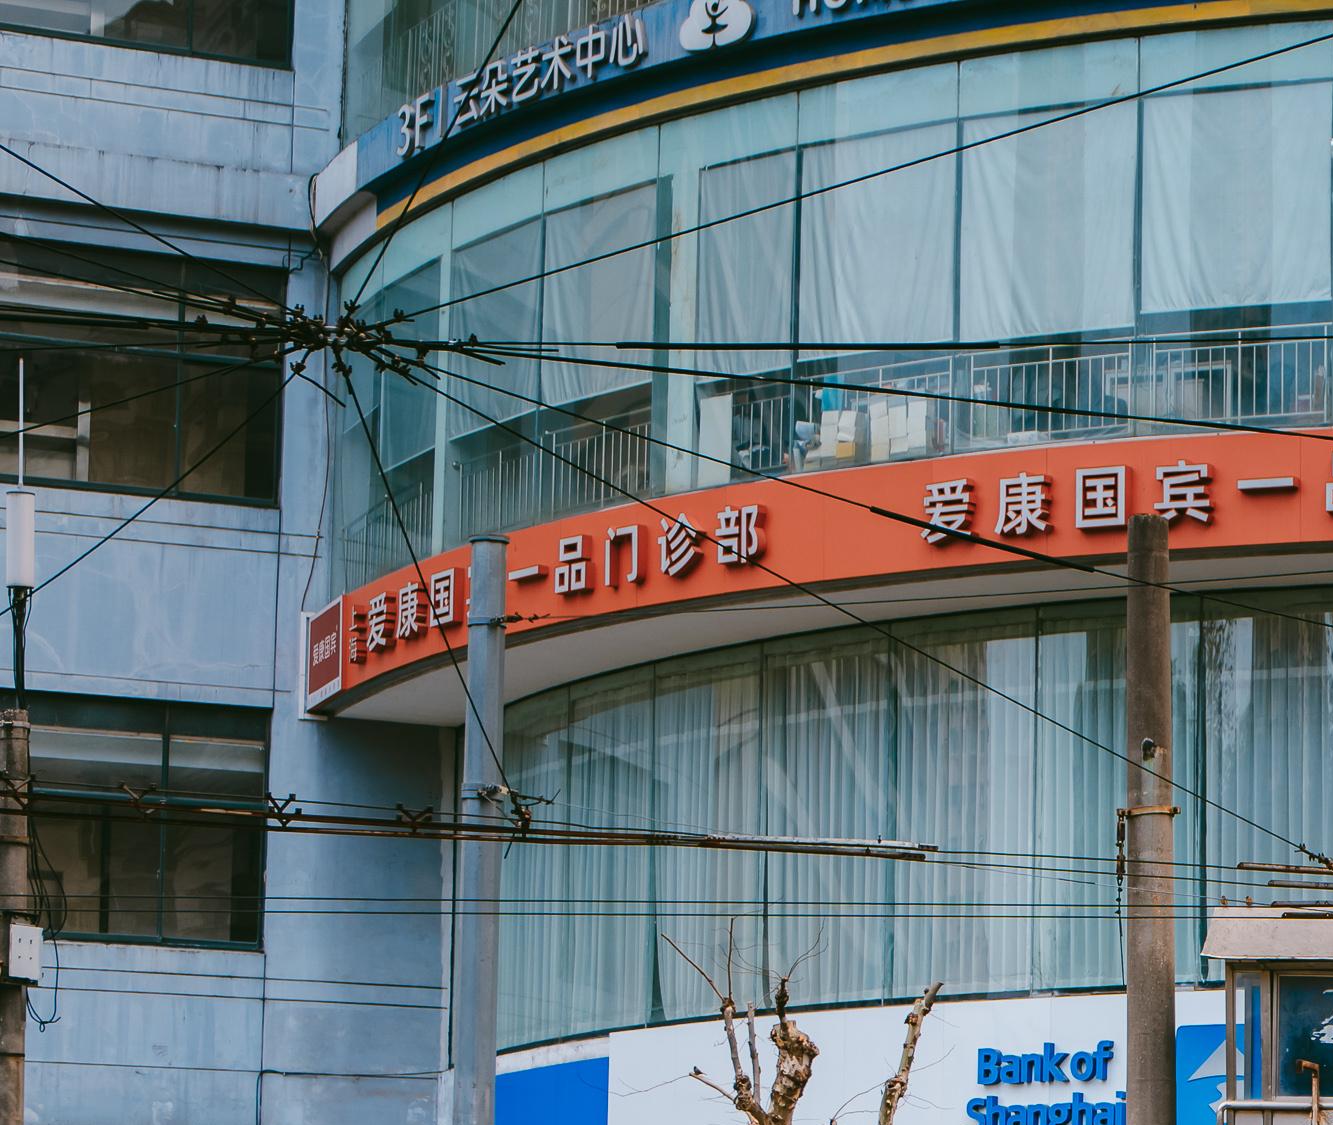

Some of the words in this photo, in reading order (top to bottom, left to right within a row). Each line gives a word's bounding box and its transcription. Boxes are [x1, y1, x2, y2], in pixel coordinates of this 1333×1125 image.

[397, 93, 432, 155] 3F
[454, 14, 644, 124] 云朵艺术中心
[367, 504, 768, 652] 爱康国一品门诊部
[977, 1042, 1069, 1085] Bank
[1070, 1040, 1114, 1081] of
